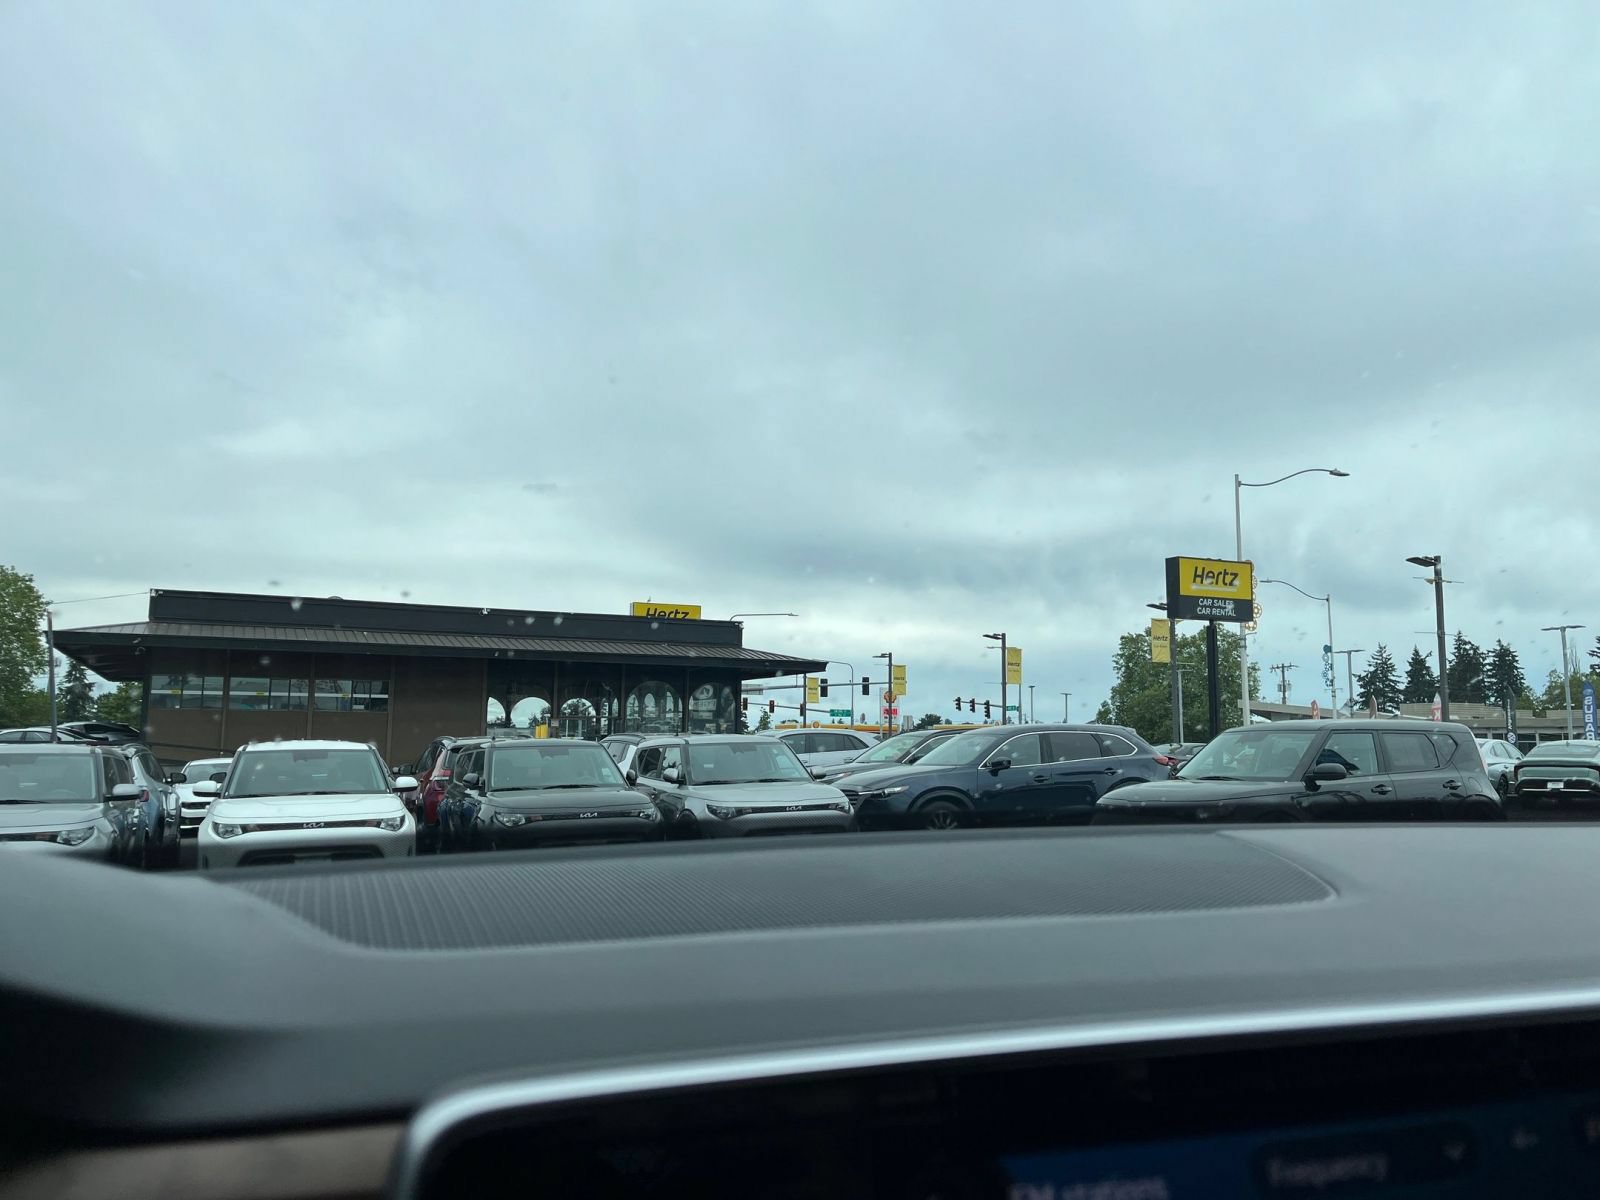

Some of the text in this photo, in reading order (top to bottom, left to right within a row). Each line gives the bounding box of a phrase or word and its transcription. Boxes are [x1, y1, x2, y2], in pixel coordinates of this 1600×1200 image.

[1192, 566, 1239, 587] Hertz
[1198, 598, 1234, 608] CAR SALES
[646, 607, 690, 619] Hertz
[1197, 607, 1236, 617] CAR RENTAL
